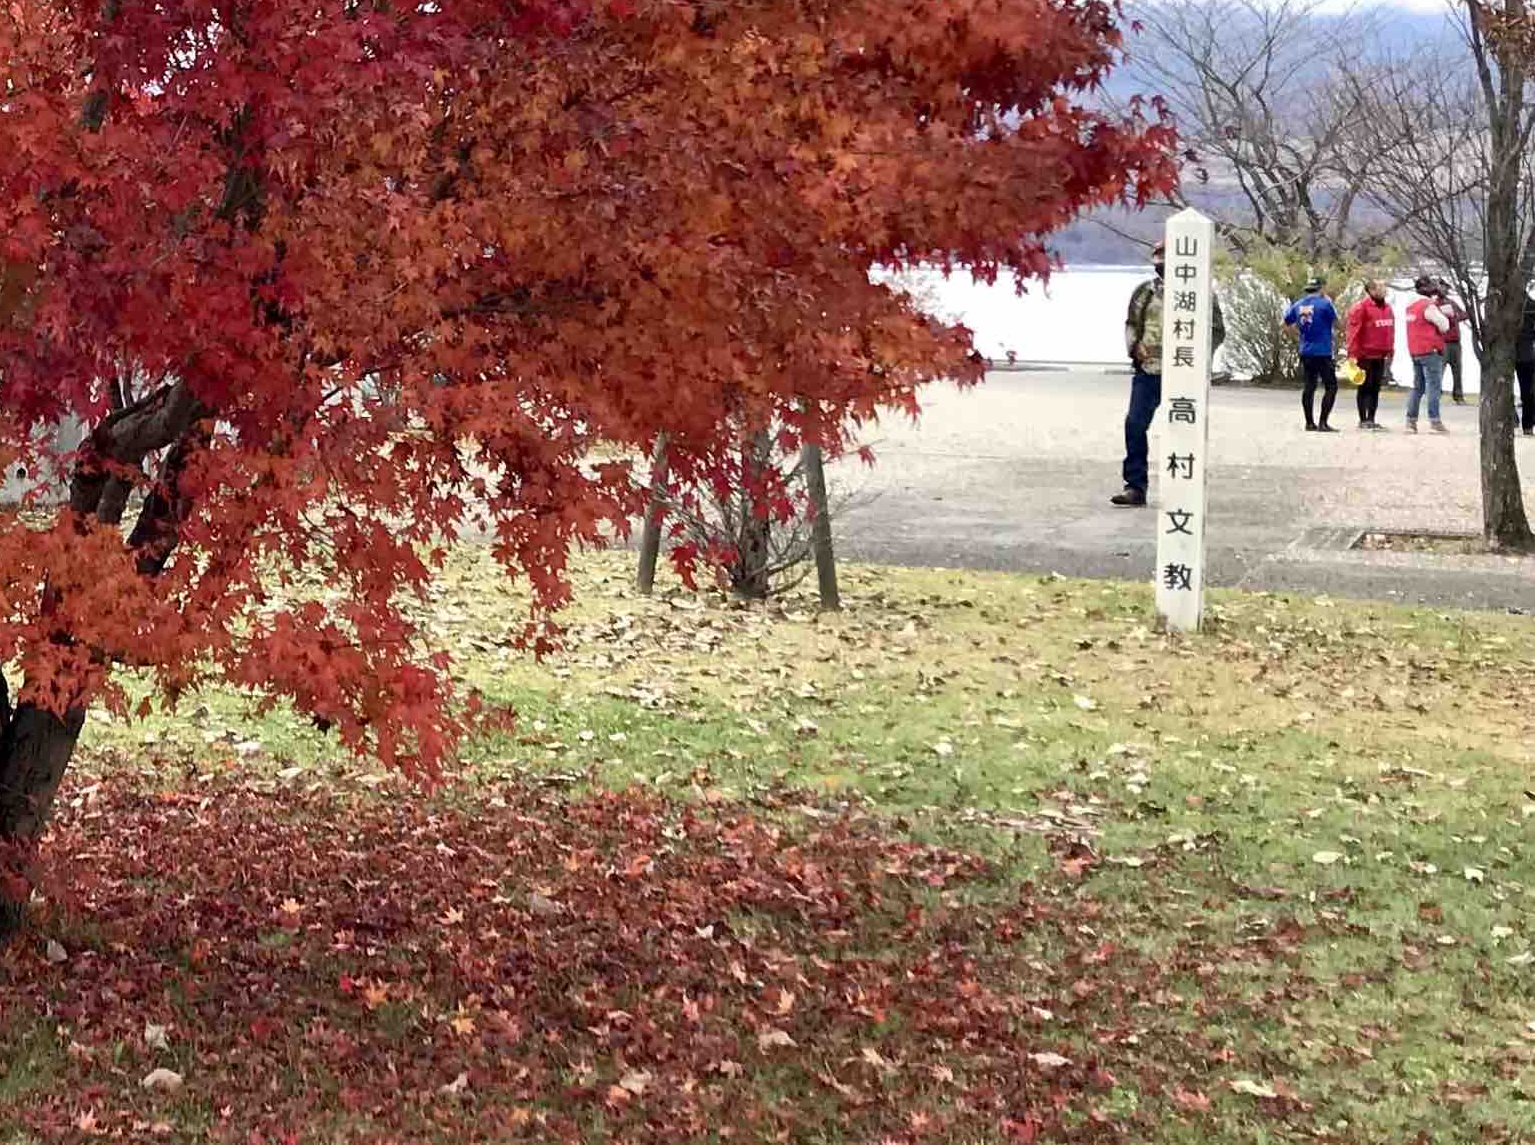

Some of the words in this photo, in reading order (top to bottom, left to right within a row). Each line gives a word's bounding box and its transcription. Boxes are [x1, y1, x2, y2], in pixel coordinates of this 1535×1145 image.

[1172, 235, 1199, 368] 山中湖村長
[1163, 396, 1197, 592] 高村文教
